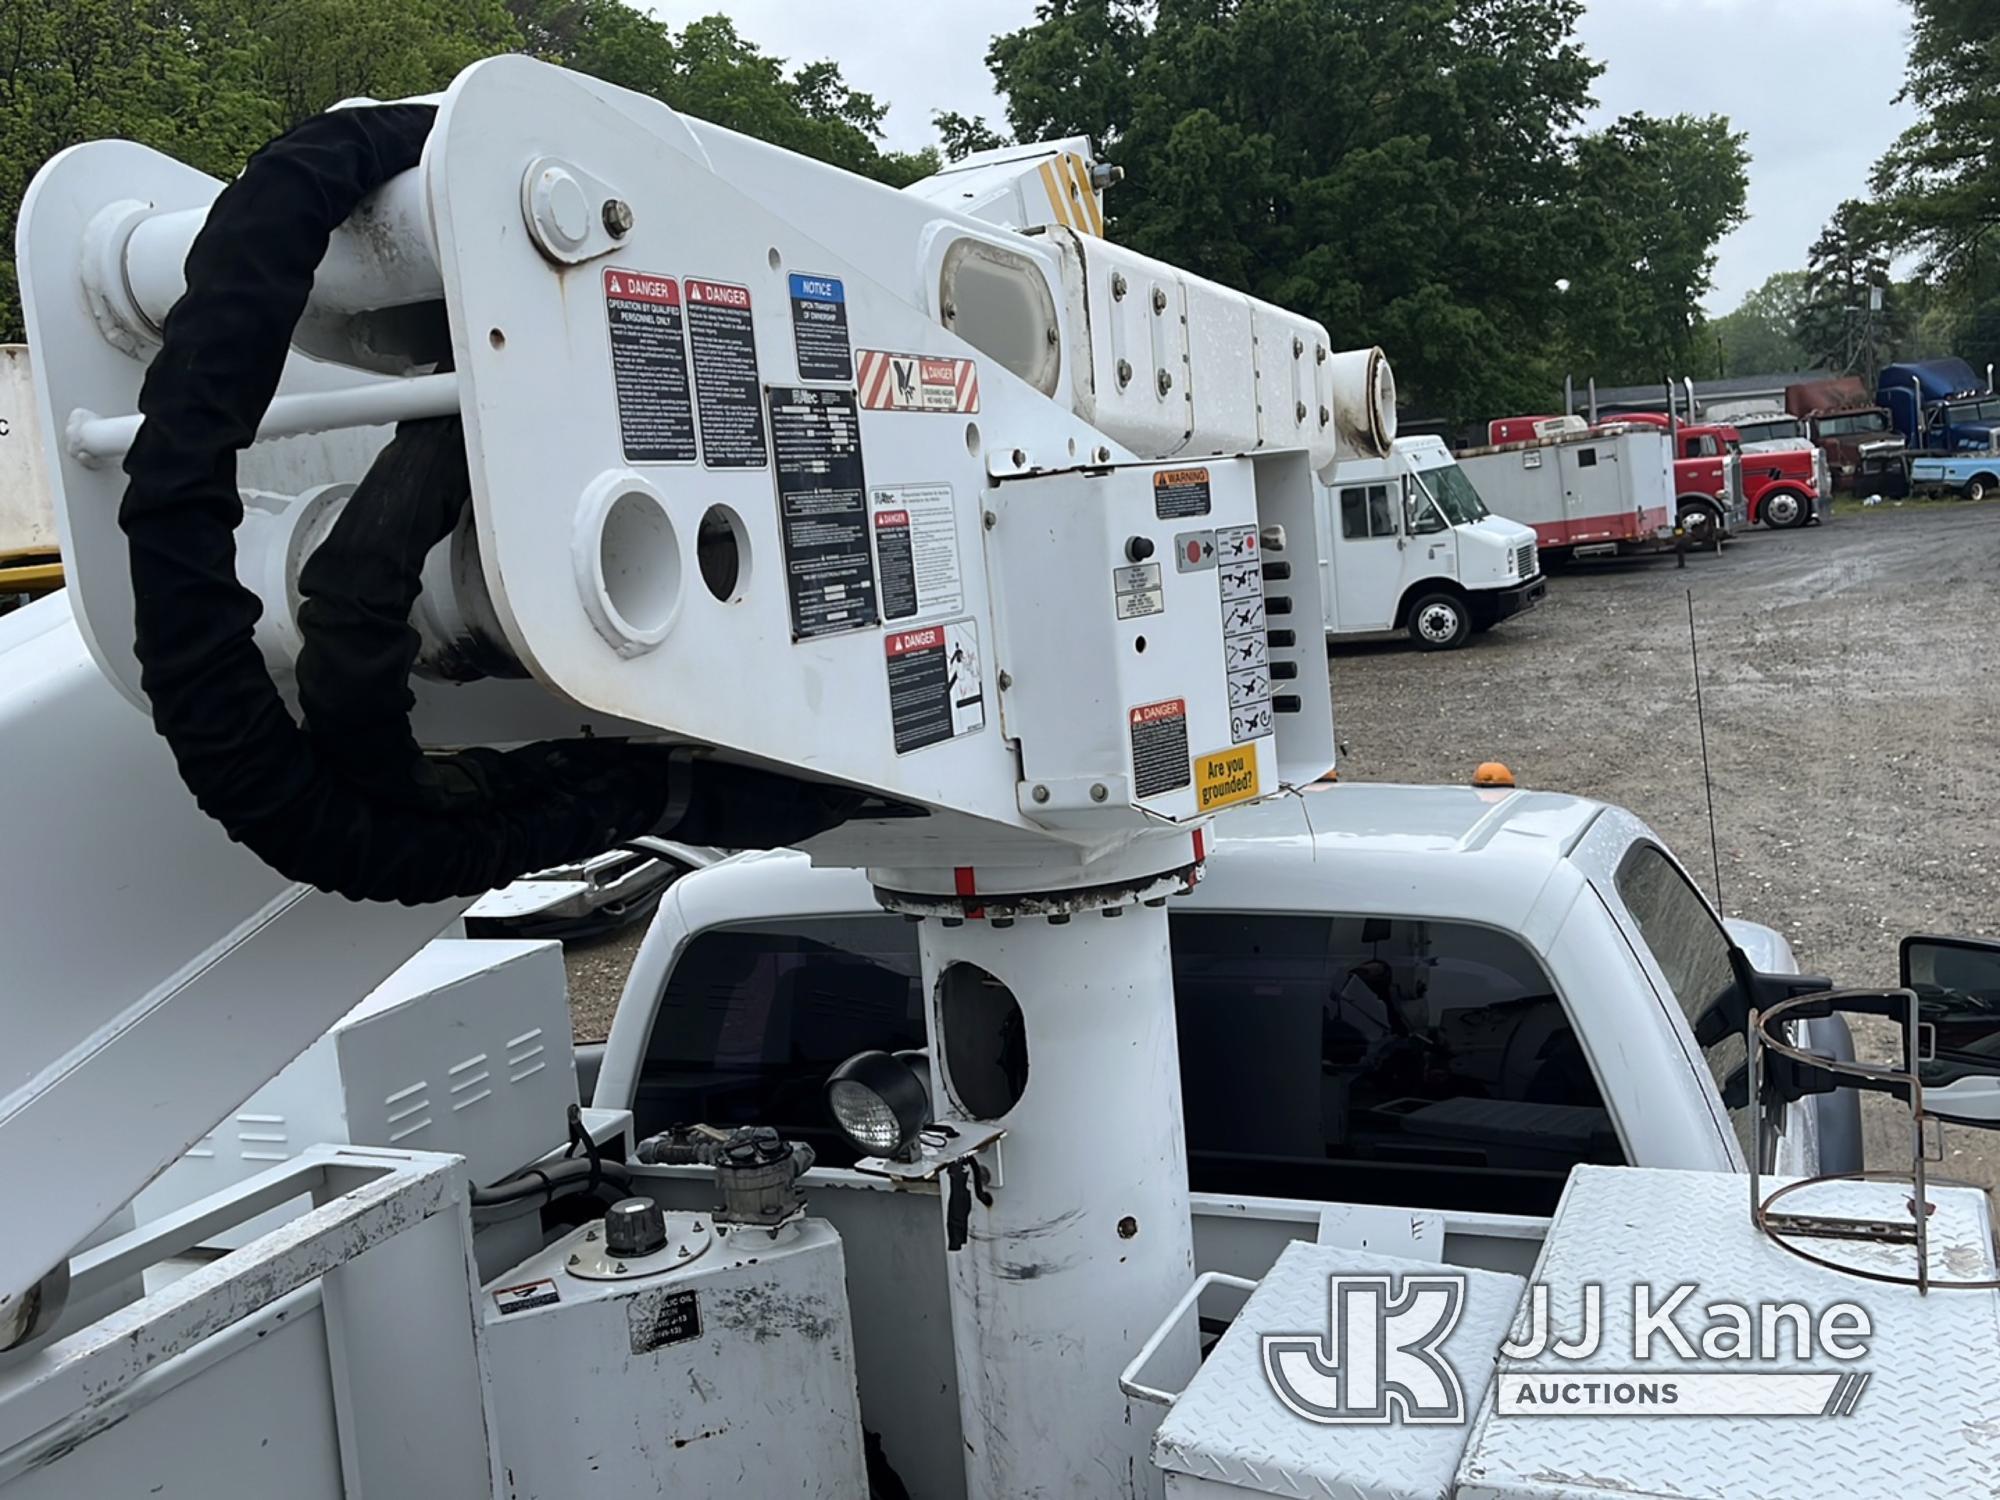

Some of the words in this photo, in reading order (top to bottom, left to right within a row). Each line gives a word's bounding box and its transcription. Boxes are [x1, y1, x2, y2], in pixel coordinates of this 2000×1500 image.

[627, 278, 669, 298] DANGER
[706, 286, 747, 305] DANGER
[802, 280, 832, 296] NOTICE
[929, 366, 952, 380] DANGER
[1167, 471, 1205, 483] WARNING
[904, 630, 936, 648] DANGER
[1143, 702, 1179, 720] DANGER
[1208, 760, 1224, 779] Are
[1227, 758, 1244, 777] you
[1202, 771, 1252, 805] grounded?
